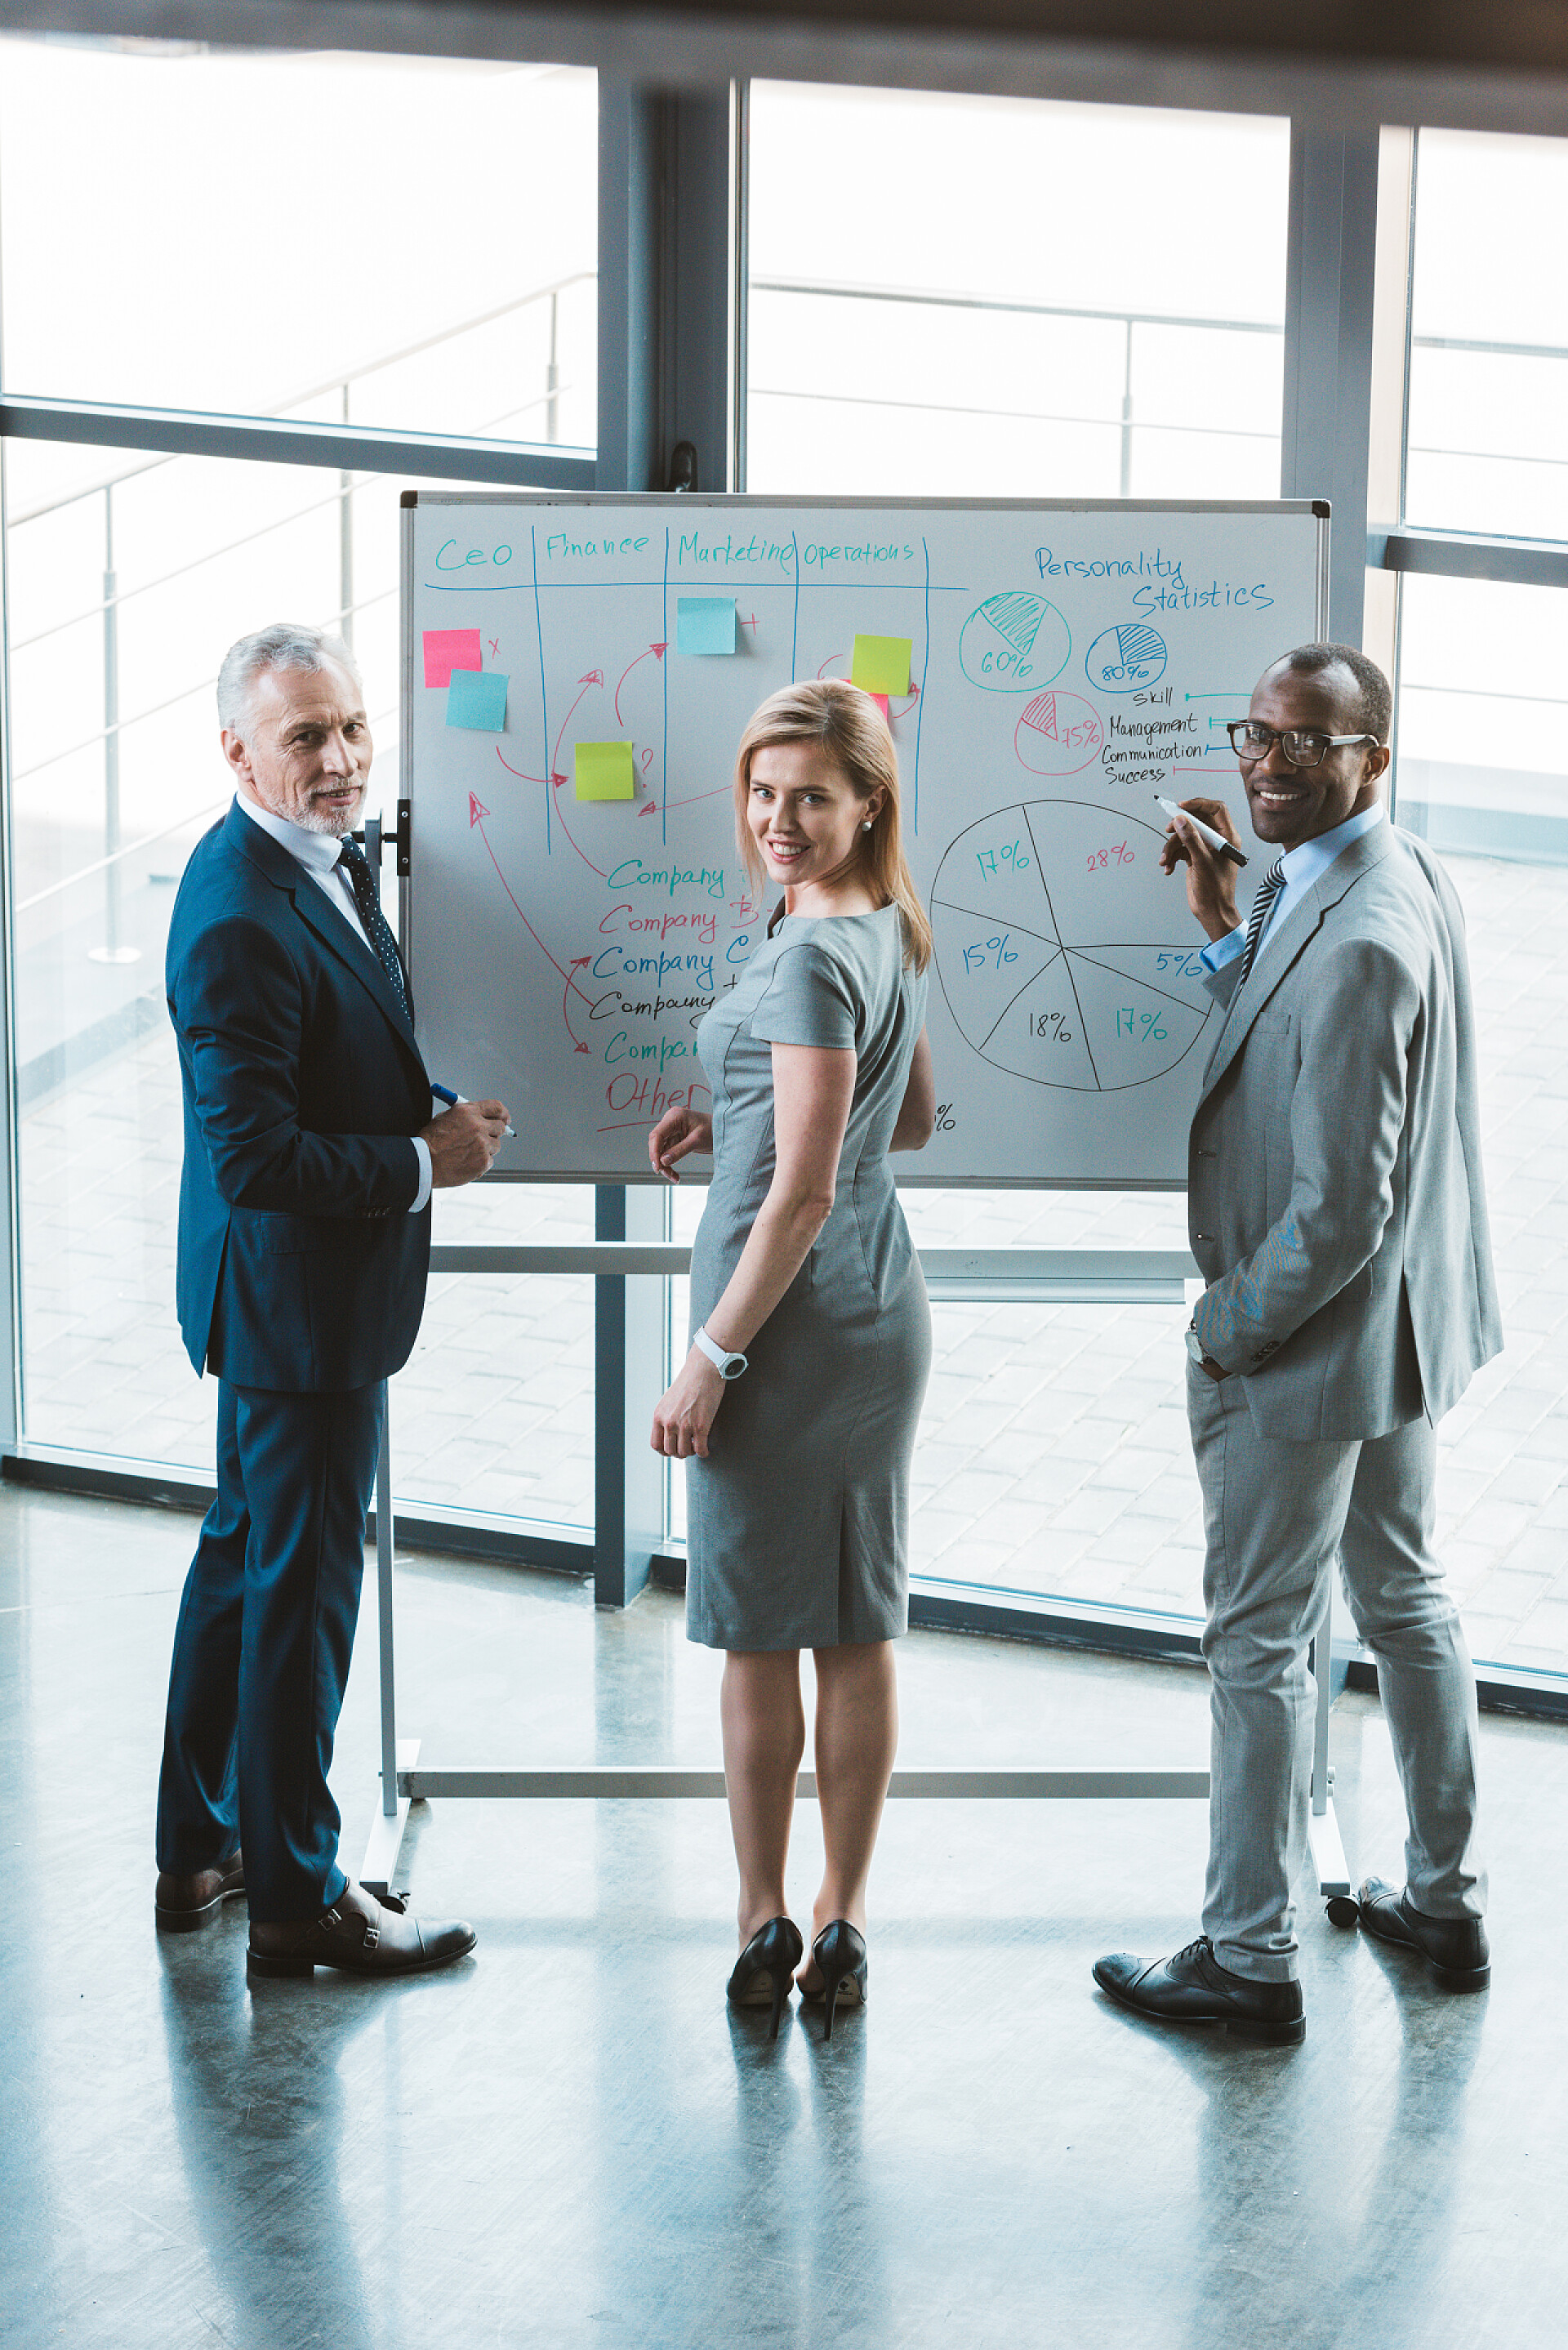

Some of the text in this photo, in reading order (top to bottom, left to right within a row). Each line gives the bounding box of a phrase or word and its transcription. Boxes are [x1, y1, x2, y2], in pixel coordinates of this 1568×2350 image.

[546, 533, 650, 560] Finance
[678, 530, 794, 576] Marketing
[1034, 546, 1183, 590] Personality
[1132, 578, 1275, 619] Statistics
[981, 651, 1034, 678] 60%
[1101, 664, 1151, 682] 80%
[1062, 720, 1100, 749] 75%
[1109, 712, 1199, 746] Management
[1101, 742, 1202, 765] Communication
[1104, 766, 1166, 785] Success
[976, 840, 1030, 882] 17%
[1086, 841, 1136, 872] 28%
[607, 859, 725, 899] Company
[599, 904, 719, 943] Company
[592, 946, 715, 991] Company
[725, 934, 751, 964] C
[961, 934, 1019, 974] 15%
[1156, 952, 1204, 977] 5%
[1029, 1012, 1072, 1042] 18%
[1116, 1007, 1168, 1042] 17%
